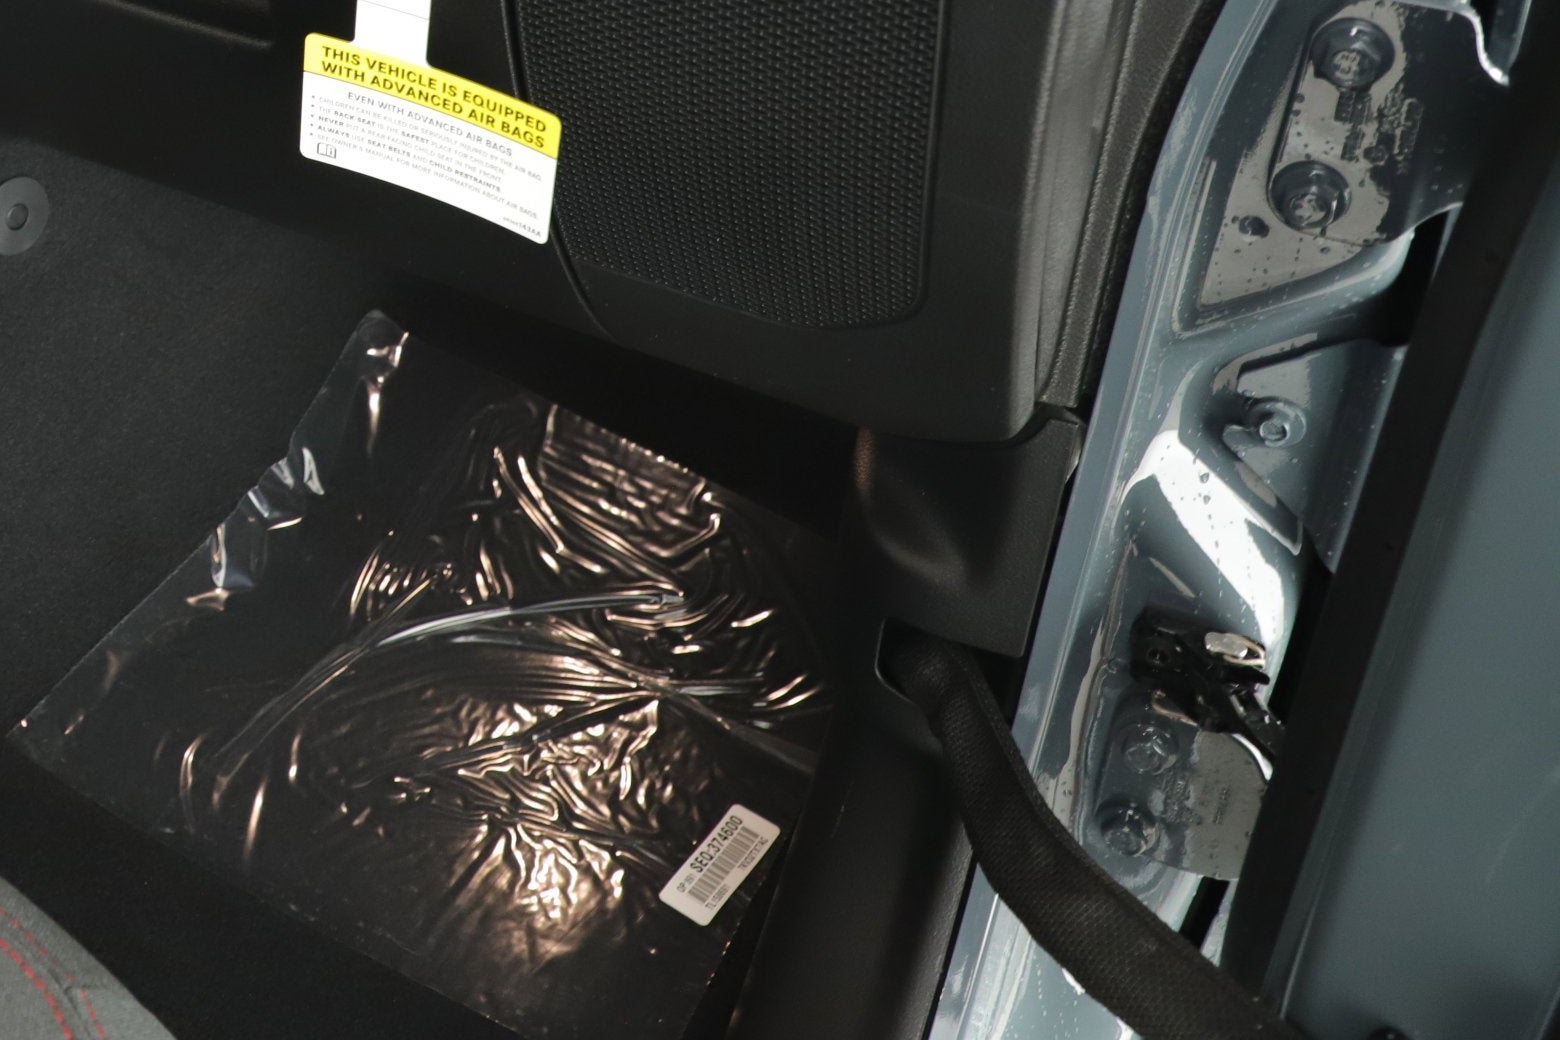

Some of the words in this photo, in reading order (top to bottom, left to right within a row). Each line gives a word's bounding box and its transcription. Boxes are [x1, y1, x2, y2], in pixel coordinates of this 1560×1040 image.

[322, 46, 360, 66] THIS
[366, 58, 437, 90] VEHICLE
[442, 82, 457, 98] IS
[463, 90, 546, 133] EQUIPPED
[322, 61, 365, 82] WITH
[370, 76, 463, 114] ADVANCED
[468, 109, 496, 128] AIR
[501, 121, 545, 149] BAGS
[317, 124, 350, 138] ALWAYS
[367, 139, 386, 148] SEAT
[387, 145, 411, 157] BELTS
[428, 159, 453, 173] CHILD
[318, 115, 344, 126] NEVER
[333, 110, 354, 119] BACK
[357, 117, 375, 126] SEAT
[400, 130, 429, 143] SAFEST
[347, 91, 375, 105] EVEN
[376, 100, 404, 114] WITH
[406, 110, 463, 136] ADVANCED
[465, 131, 482, 143] AIR
[484, 138, 513, 156] BAGS
[690, 815, 743, 873] SEQ:374600
